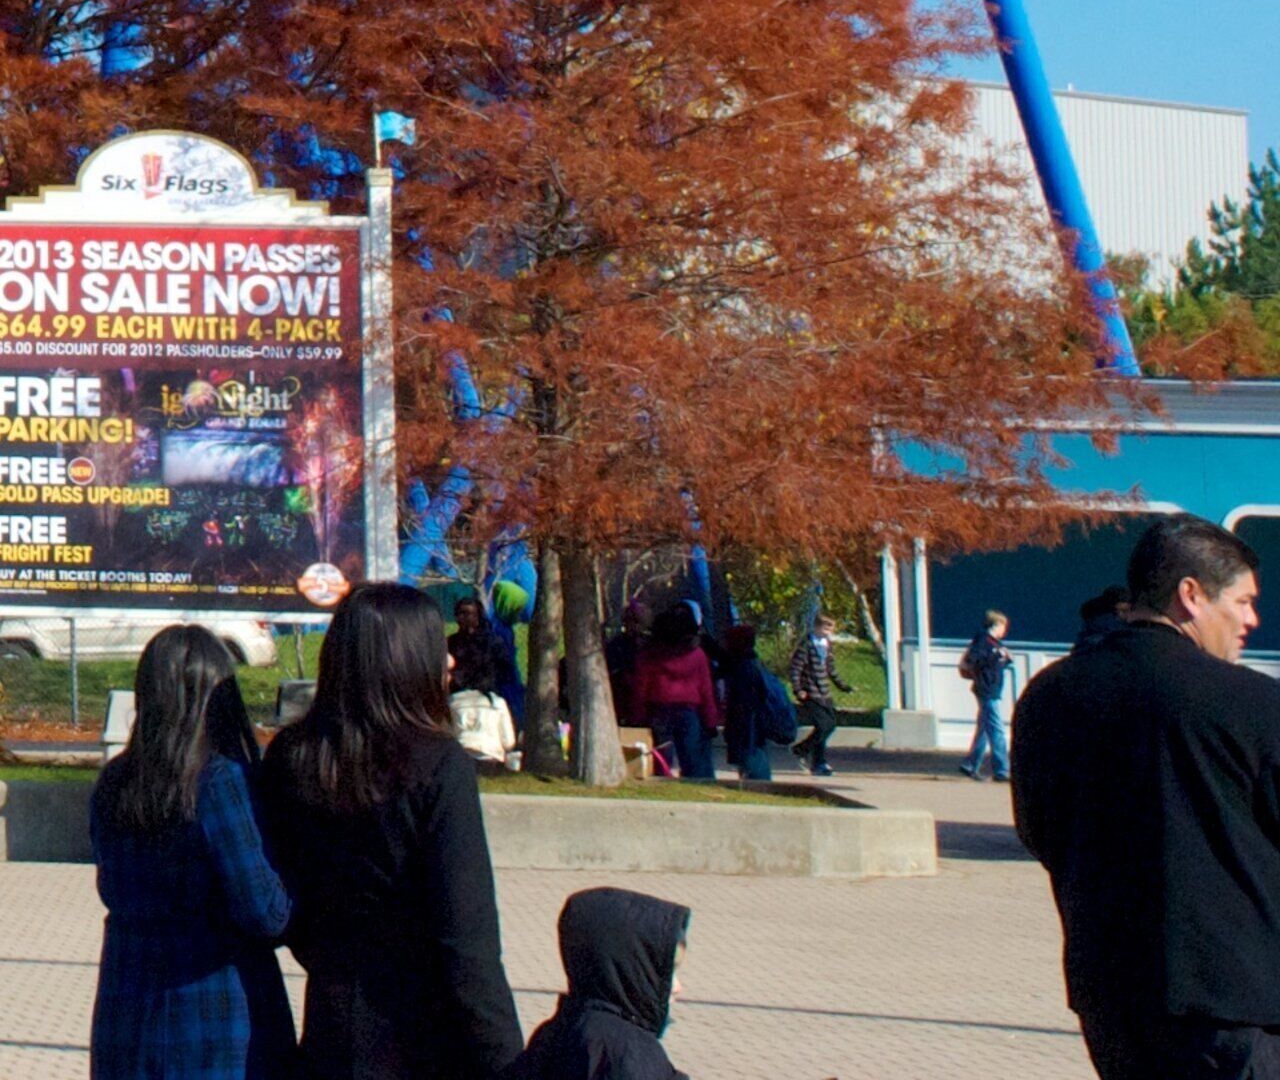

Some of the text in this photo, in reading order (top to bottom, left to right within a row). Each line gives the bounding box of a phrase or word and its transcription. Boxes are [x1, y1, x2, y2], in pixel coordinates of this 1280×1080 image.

[101, 175, 228, 195] Six Flags
[81, 240, 215, 271] SEASON
[224, 242, 342, 273] PASSES
[80, 272, 191, 314] SALE
[204, 274, 341, 317] NOW!
[96, 315, 163, 339] EACH
[171, 316, 237, 340] WITH
[247, 317, 342, 342] 4-PACK
[36, 342, 99, 356] DISCOUNT
[102, 342, 127, 356] FOR
[130, 343, 163, 357] 2012
[296, 346, 343, 360] $59.99
[42, 486, 84, 504] PASS
[88, 486, 170, 506] UPGRADE!
[54, 545, 92, 563] FEST
[19, 568, 33, 580] AT
[35, 569, 56, 580] THE
[58, 570, 97, 582] TICKET
[99, 571, 147, 583] BOOTHS
[149, 572, 192, 583] TODAY!
